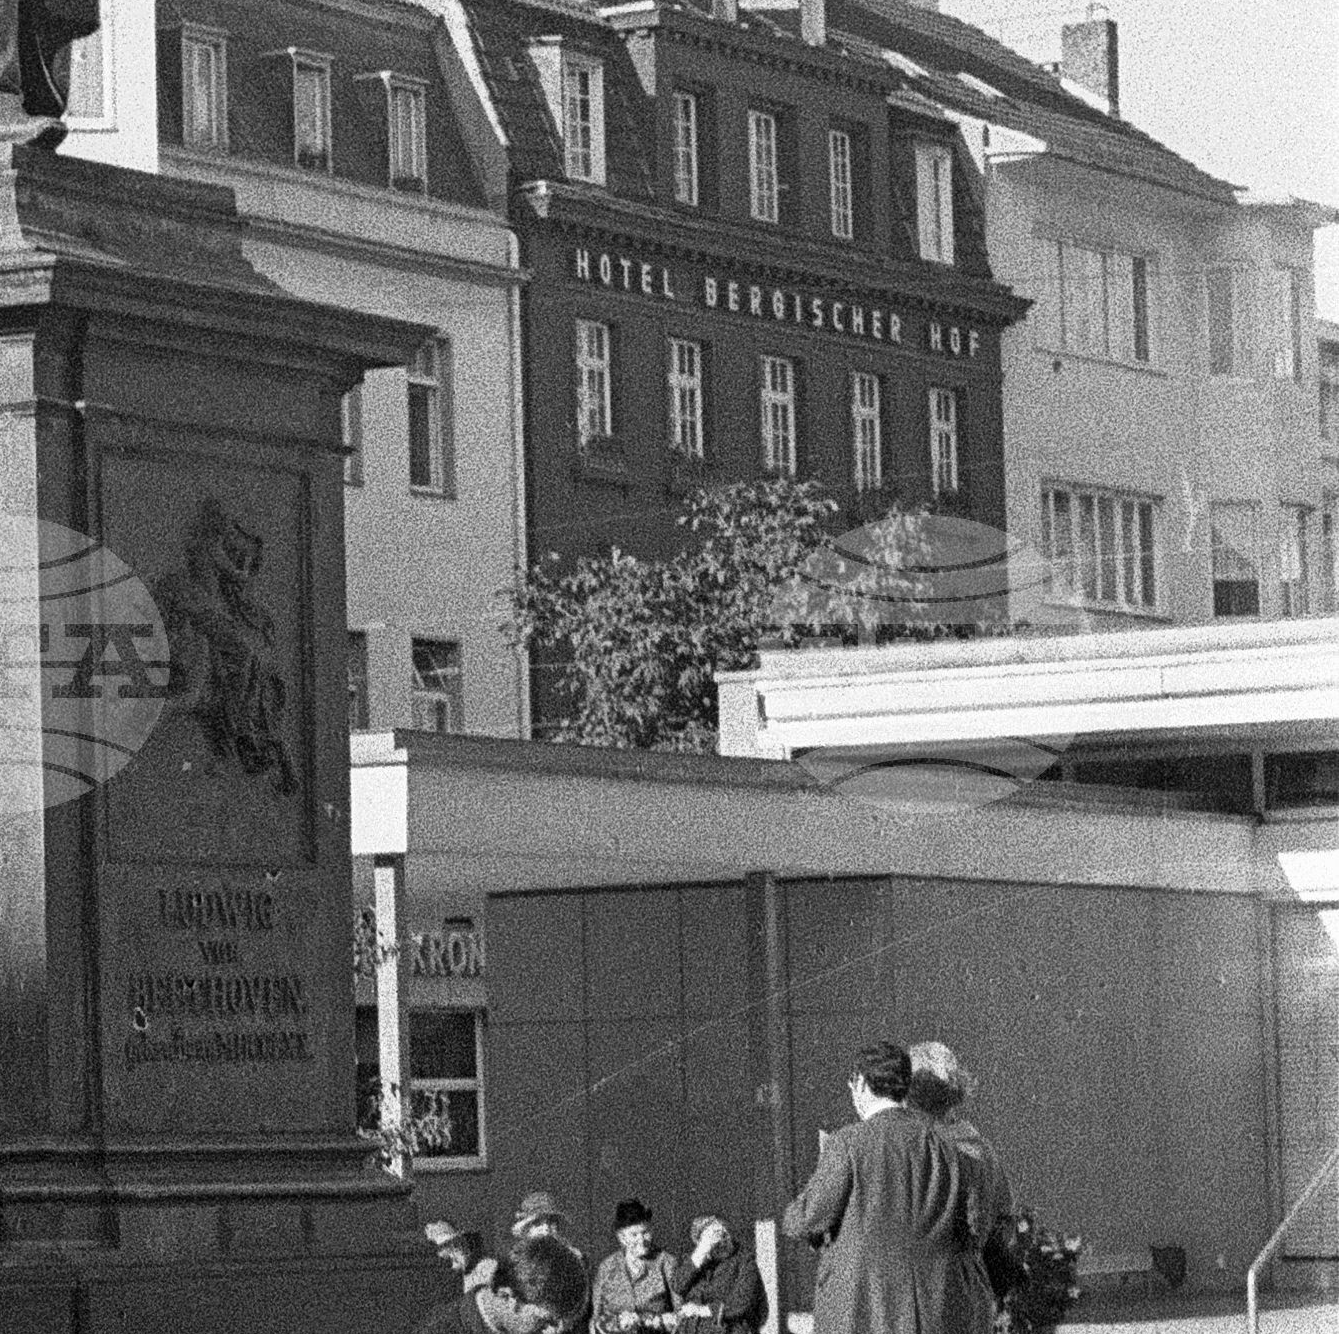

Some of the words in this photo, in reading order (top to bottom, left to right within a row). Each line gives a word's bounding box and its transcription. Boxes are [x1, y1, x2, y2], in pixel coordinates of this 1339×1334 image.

[576, 248, 675, 301] HOTEL
[704, 276, 903, 345] BERGISCHER
[930, 324, 982, 358] HOF
